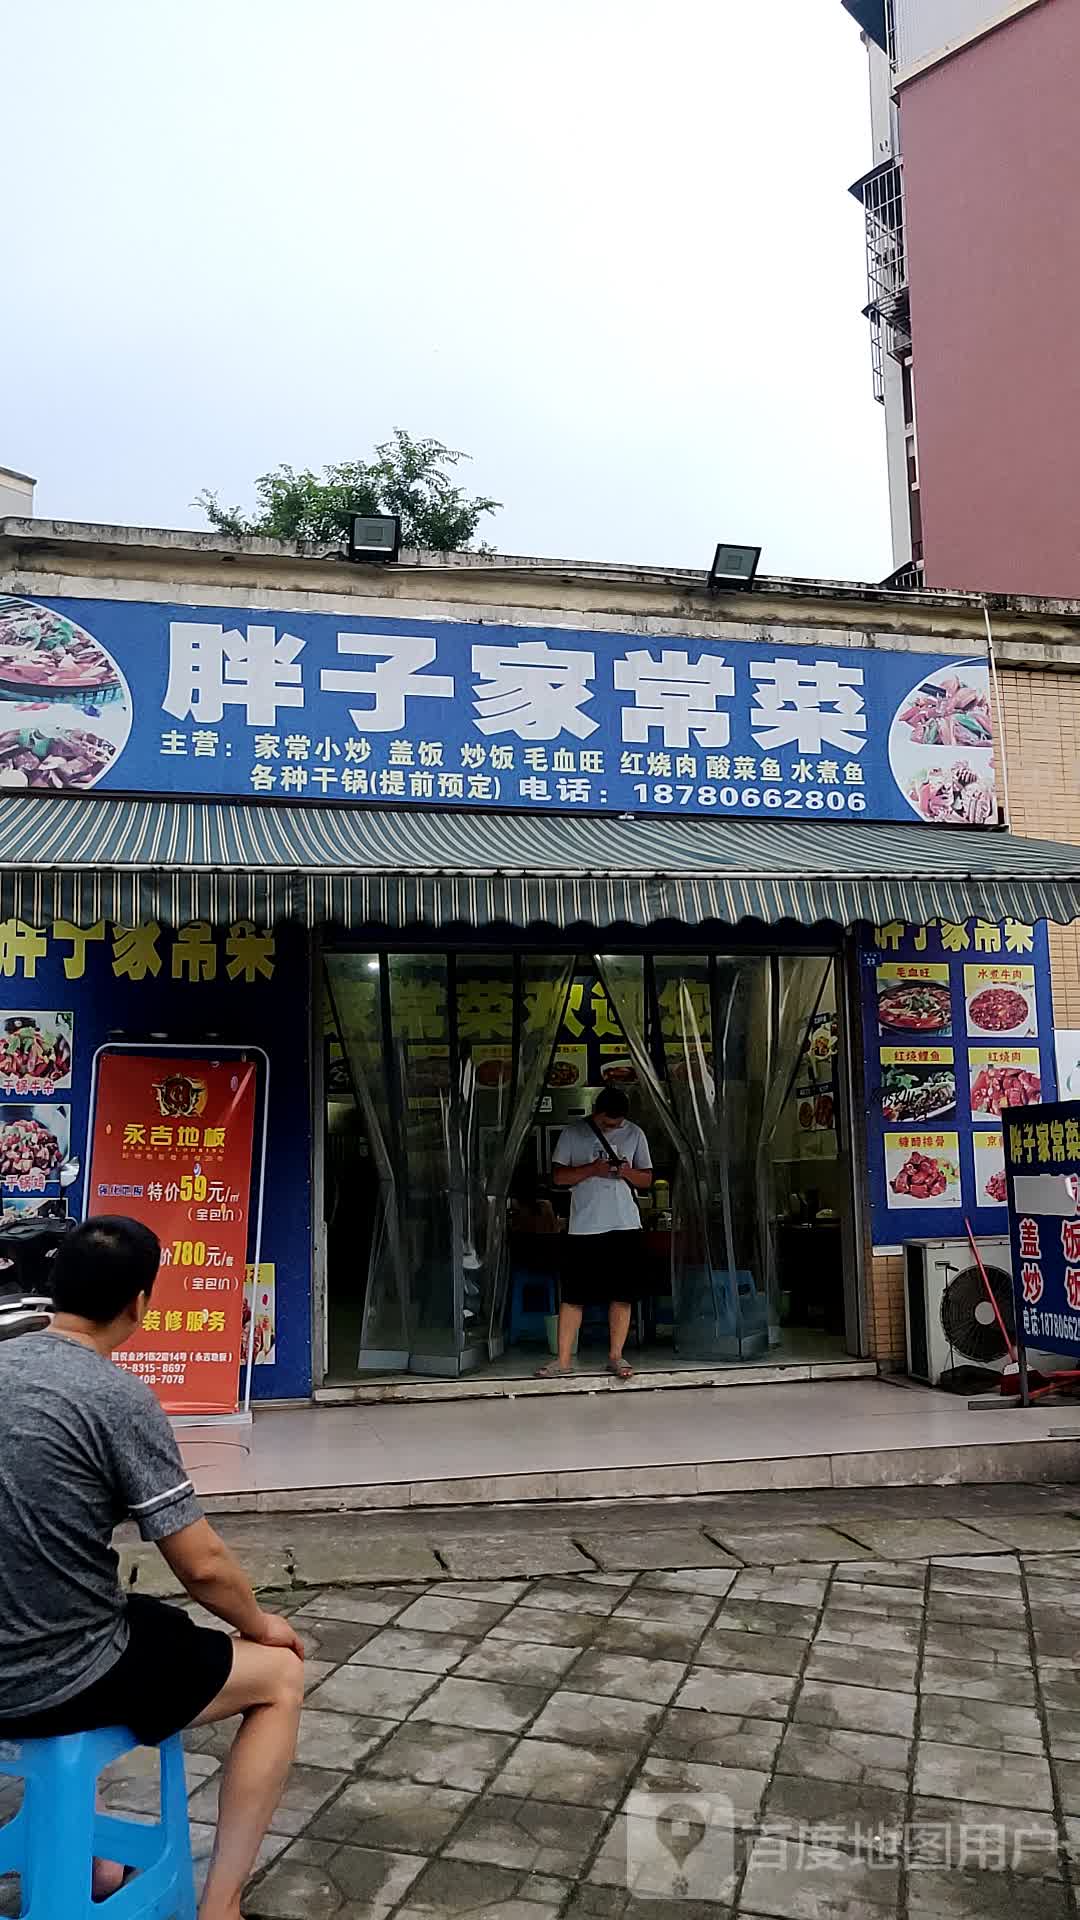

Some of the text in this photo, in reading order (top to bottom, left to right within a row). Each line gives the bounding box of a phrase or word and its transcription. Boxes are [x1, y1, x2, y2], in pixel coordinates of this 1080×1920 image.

[162, 621, 868, 756] 胖子家常菜
[160, 730, 864, 786] 主营： 家常小炒 盖饭 炒饭 毛血旺 红烧肉 酸菜鱼 水煮鱼
[250, 763, 867, 812] 各种干锅(提前预定) 电话： 18780662806
[896, 967, 930, 978] 毛血旺
[977, 968, 1023, 980] 水煮牛肉
[894, 1050, 941, 1062] 红烧鲤鱼
[987, 1051, 1022, 1063] 红烧肉
[123, 1123, 226, 1148] 永吉地板
[987, 1135, 1003, 1148] 京
[1010, 1118, 1080, 1163] 胖子家常菜
[1020, 1218, 1041, 1259] 盖
[1021, 1262, 1043, 1304] 炒
[142, 1310, 226, 1332] 装修服务
[139, 1375, 185, 1385] 08-7078
